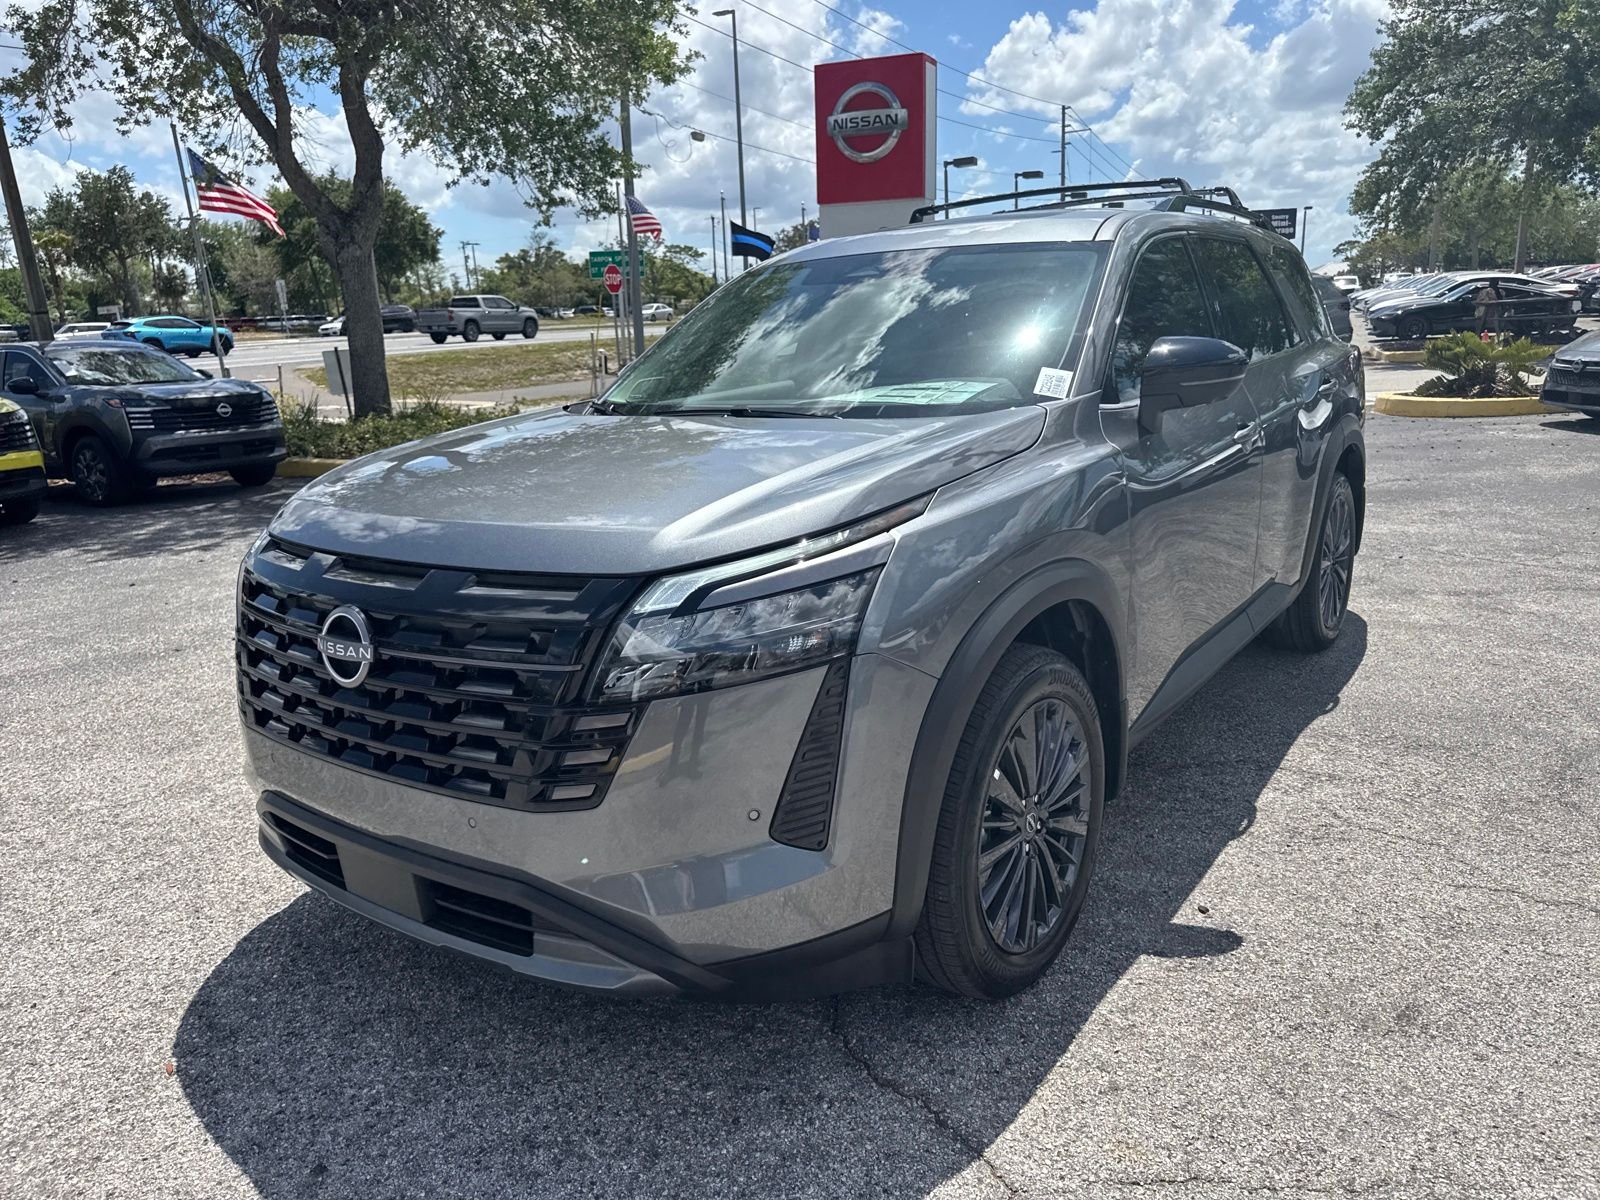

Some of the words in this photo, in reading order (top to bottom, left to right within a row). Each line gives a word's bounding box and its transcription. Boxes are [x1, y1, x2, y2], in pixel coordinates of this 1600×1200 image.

[833, 113, 899, 130] NISSAN
[605, 274, 622, 285] STOP
[318, 637, 371, 659] NISSAN
